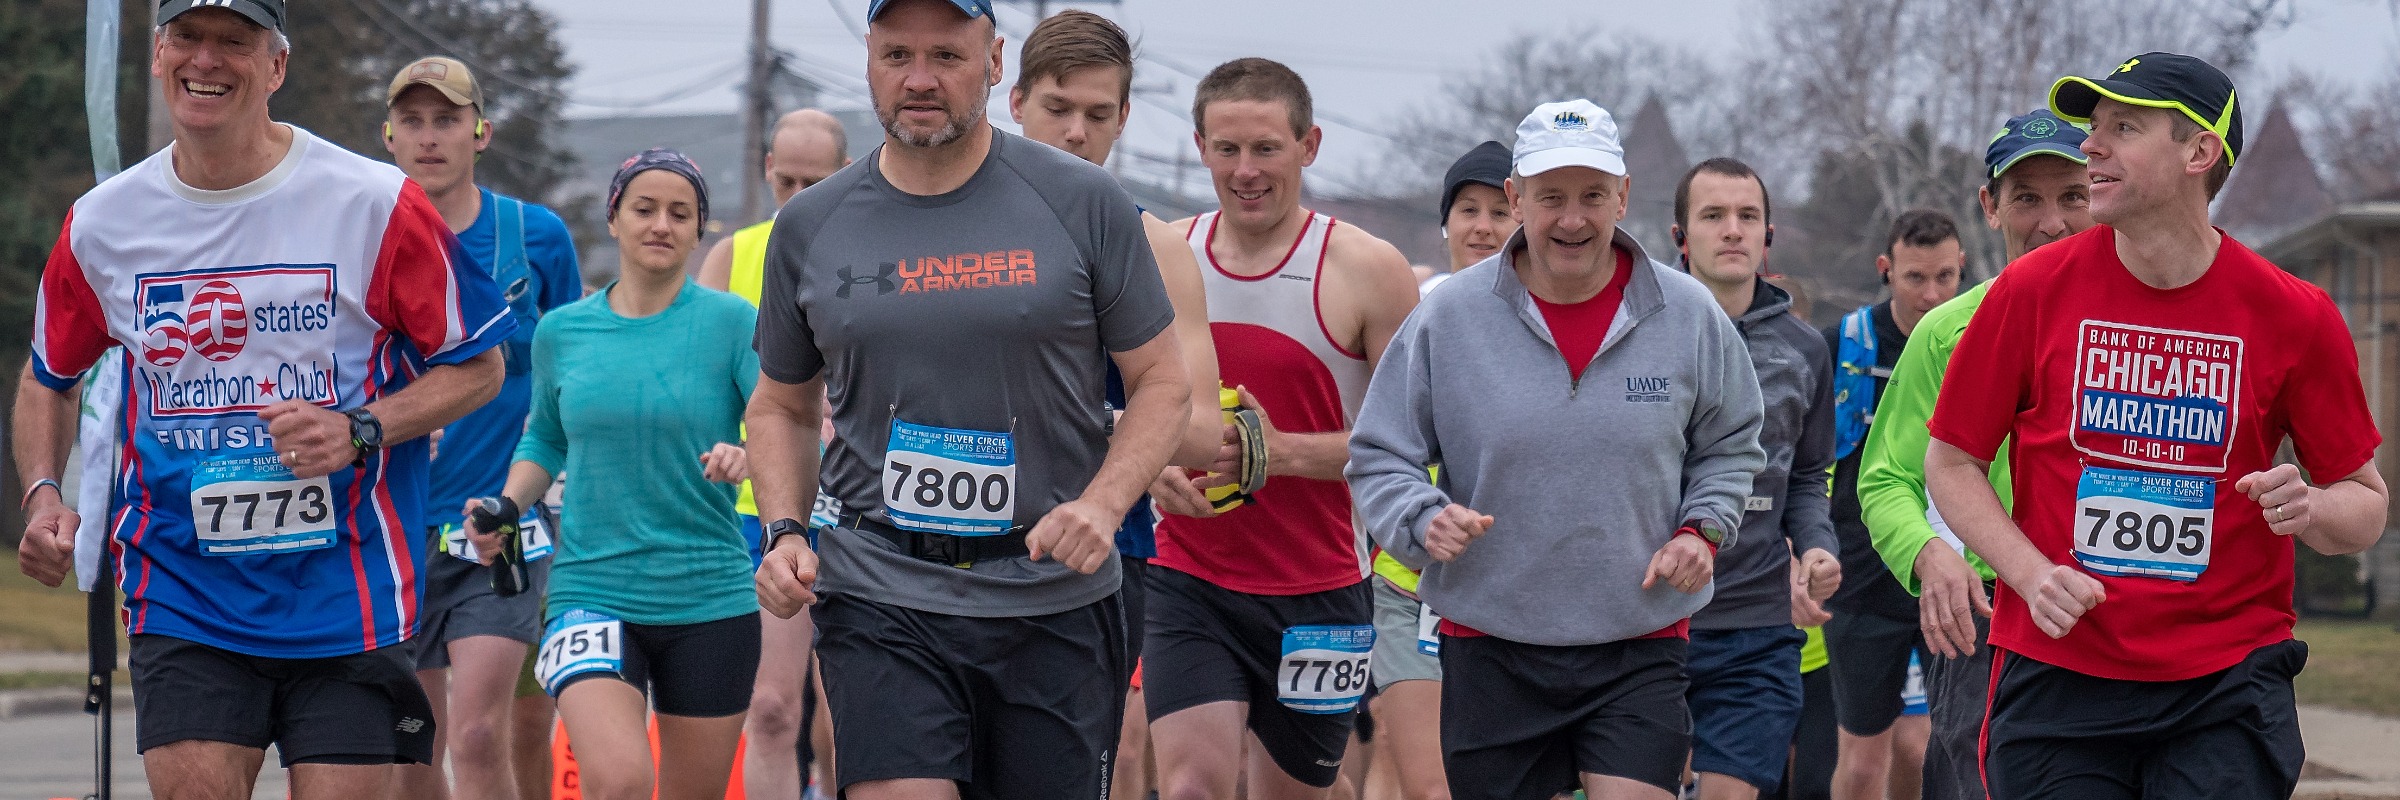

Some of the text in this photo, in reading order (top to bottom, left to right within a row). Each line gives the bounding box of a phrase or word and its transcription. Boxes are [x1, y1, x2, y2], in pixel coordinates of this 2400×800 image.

[898, 249, 1035, 279] UNDER
[899, 269, 1037, 296] ARMOUR
[141, 280, 328, 367] 50 states
[2089, 329, 2231, 360] BANK OF AMERICA
[152, 366, 256, 409] Marathon
[276, 360, 328, 402] Club
[1625, 377, 1671, 392] UMDF
[2084, 347, 2231, 404] CHICAGO
[2081, 395, 2224, 443] MARATHON
[942, 442, 1008, 455] SPORTS EVENTS
[943, 433, 1006, 448] SILVER CIRCLE
[2122, 438, 2185, 462] 10-10-10
[253, 464, 284, 473] SPORTS
[2142, 476, 2205, 490] SILVER CIRCLE
[890, 460, 1010, 513] 7800
[2141, 485, 2204, 498] SPORTS EVENTS
[200, 485, 328, 533] 7773
[2084, 507, 2206, 557] 7805
[1329, 629, 1373, 639] SILVER CIRCLE
[541, 626, 610, 680] 7751
[1287, 658, 1369, 693] 7785
[1099, 763, 1108, 800] Reebok
